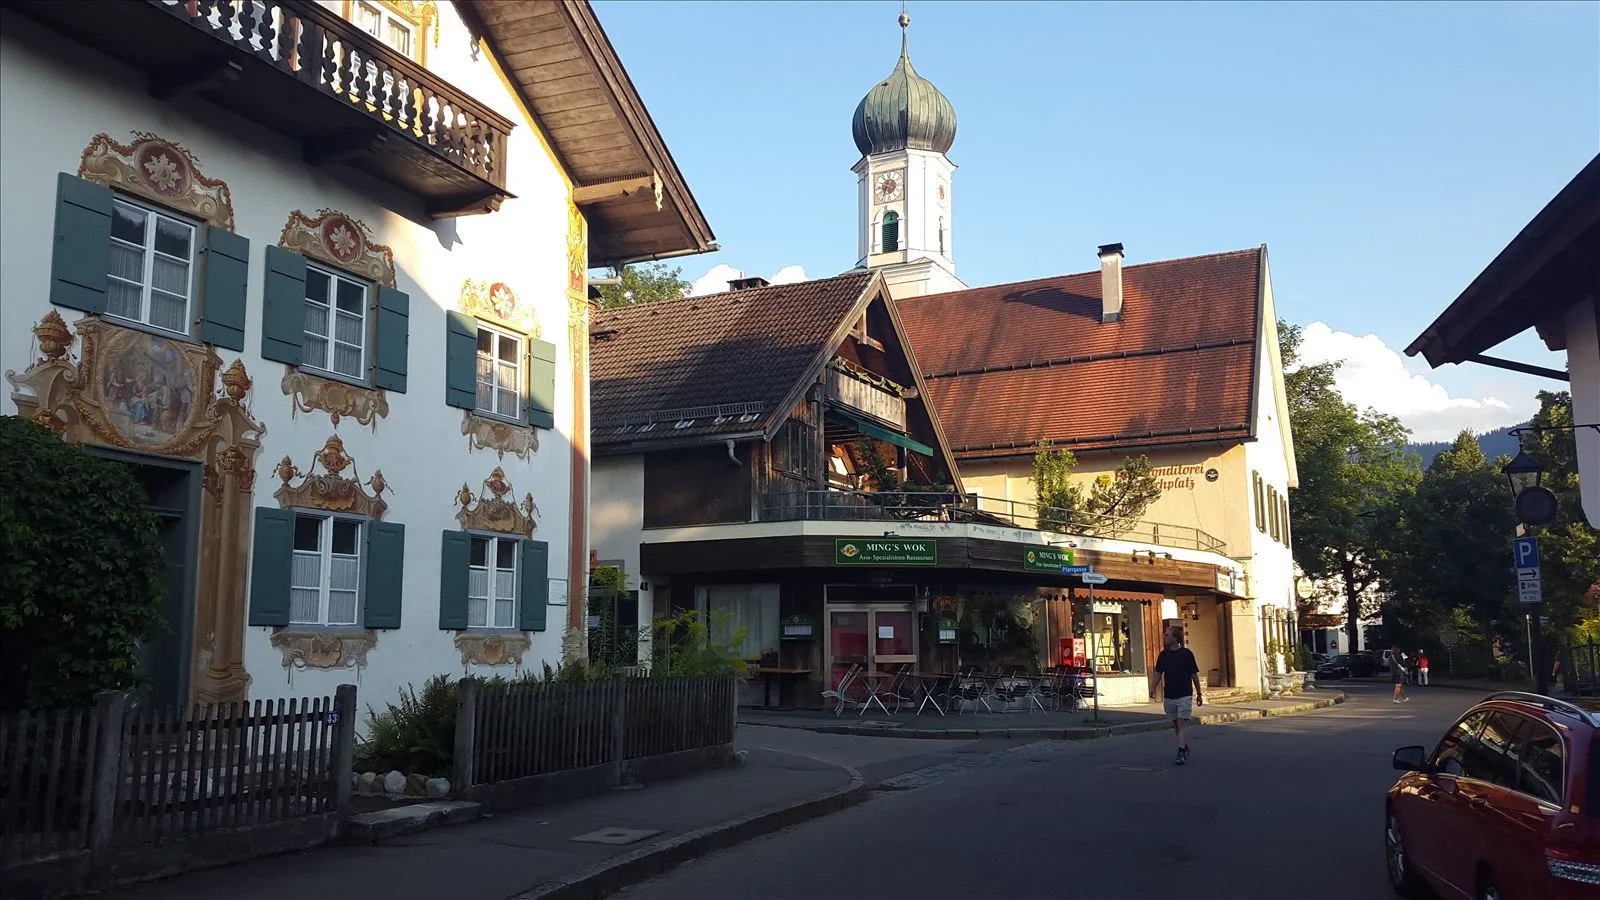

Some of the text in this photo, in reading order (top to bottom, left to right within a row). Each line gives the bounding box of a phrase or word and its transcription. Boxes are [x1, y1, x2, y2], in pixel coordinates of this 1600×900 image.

[1149, 463, 1204, 477] onditorei
[1155, 477, 1195, 490] chplatz
[866, 543, 926, 552] MING'S WOK
[1039, 552, 1069, 561] MING'S WOK
[1518, 542, 1532, 565] P
[328, 714, 337, 723] 43
